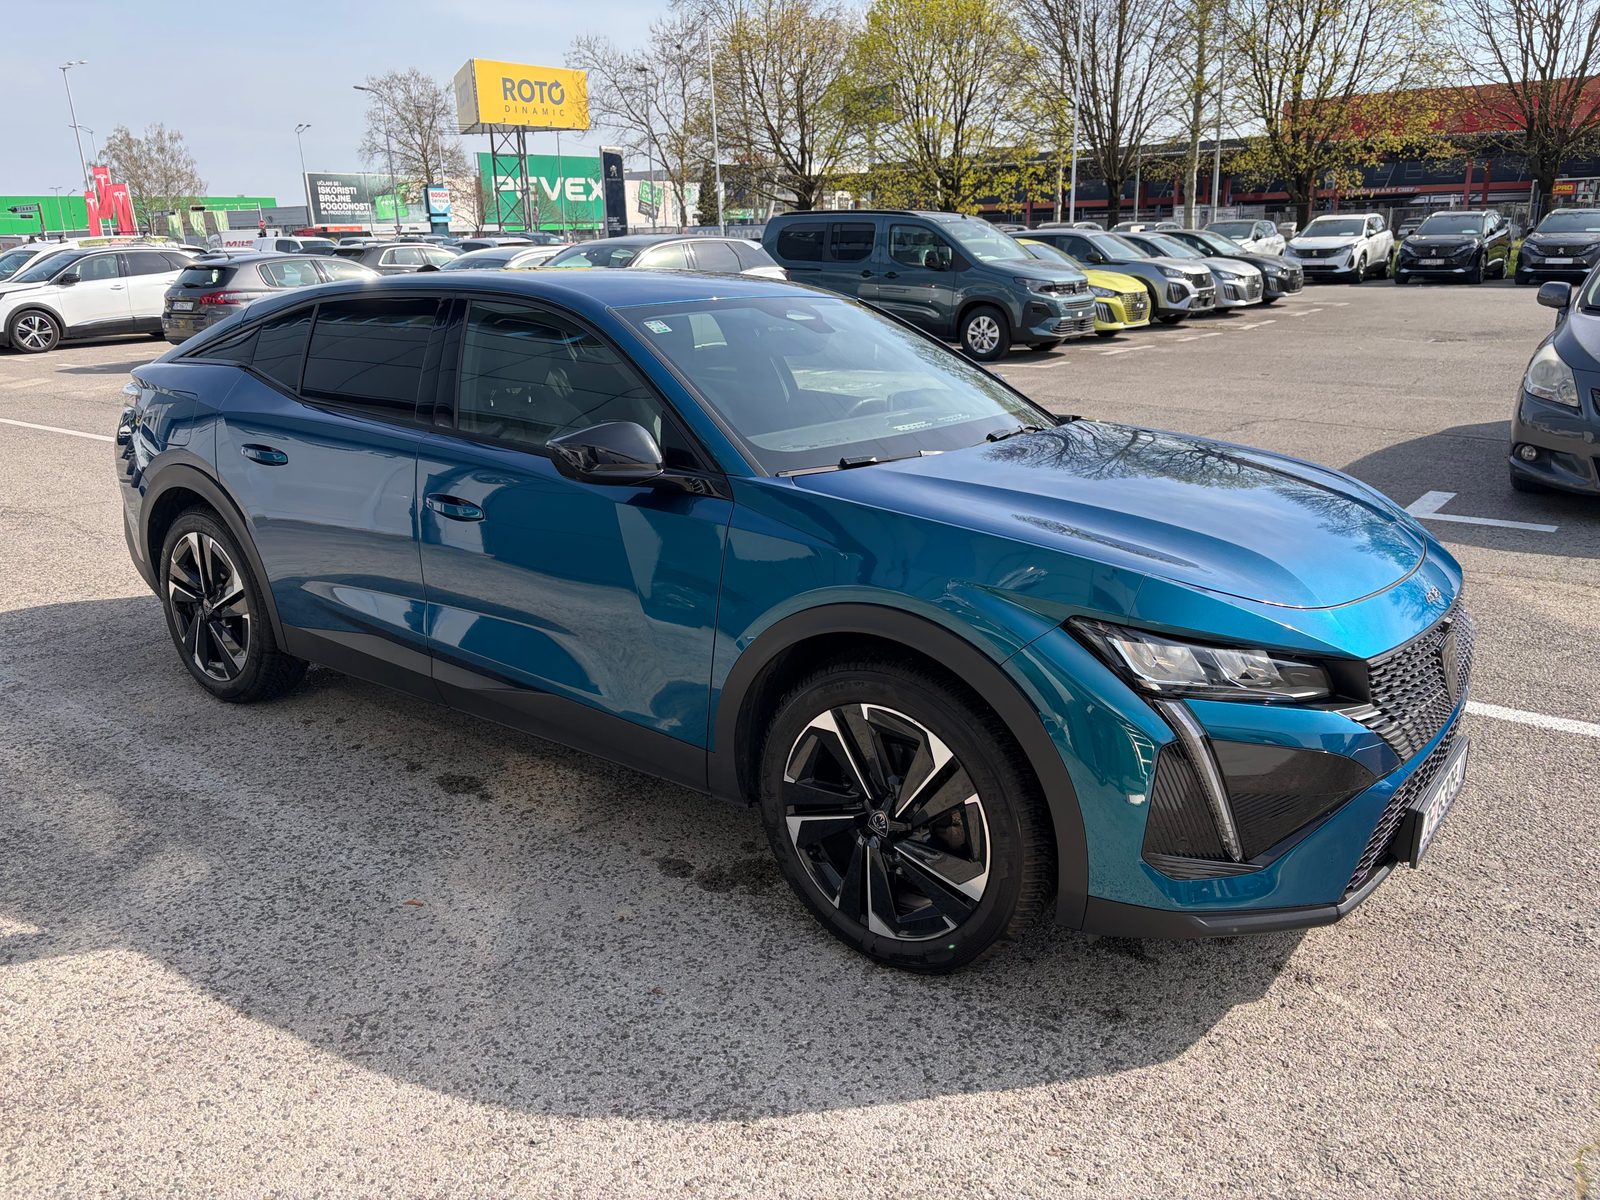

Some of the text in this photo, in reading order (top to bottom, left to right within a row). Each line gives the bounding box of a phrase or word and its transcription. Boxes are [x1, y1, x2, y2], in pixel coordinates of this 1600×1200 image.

[502, 77, 565, 105] ROTO
[505, 105, 565, 117] DINAMIC
[318, 186, 357, 195] ISKORISTI
[491, 175, 603, 202] PEVEX
[319, 194, 352, 202] BROJNE
[320, 202, 371, 211] POGODNOSTI
